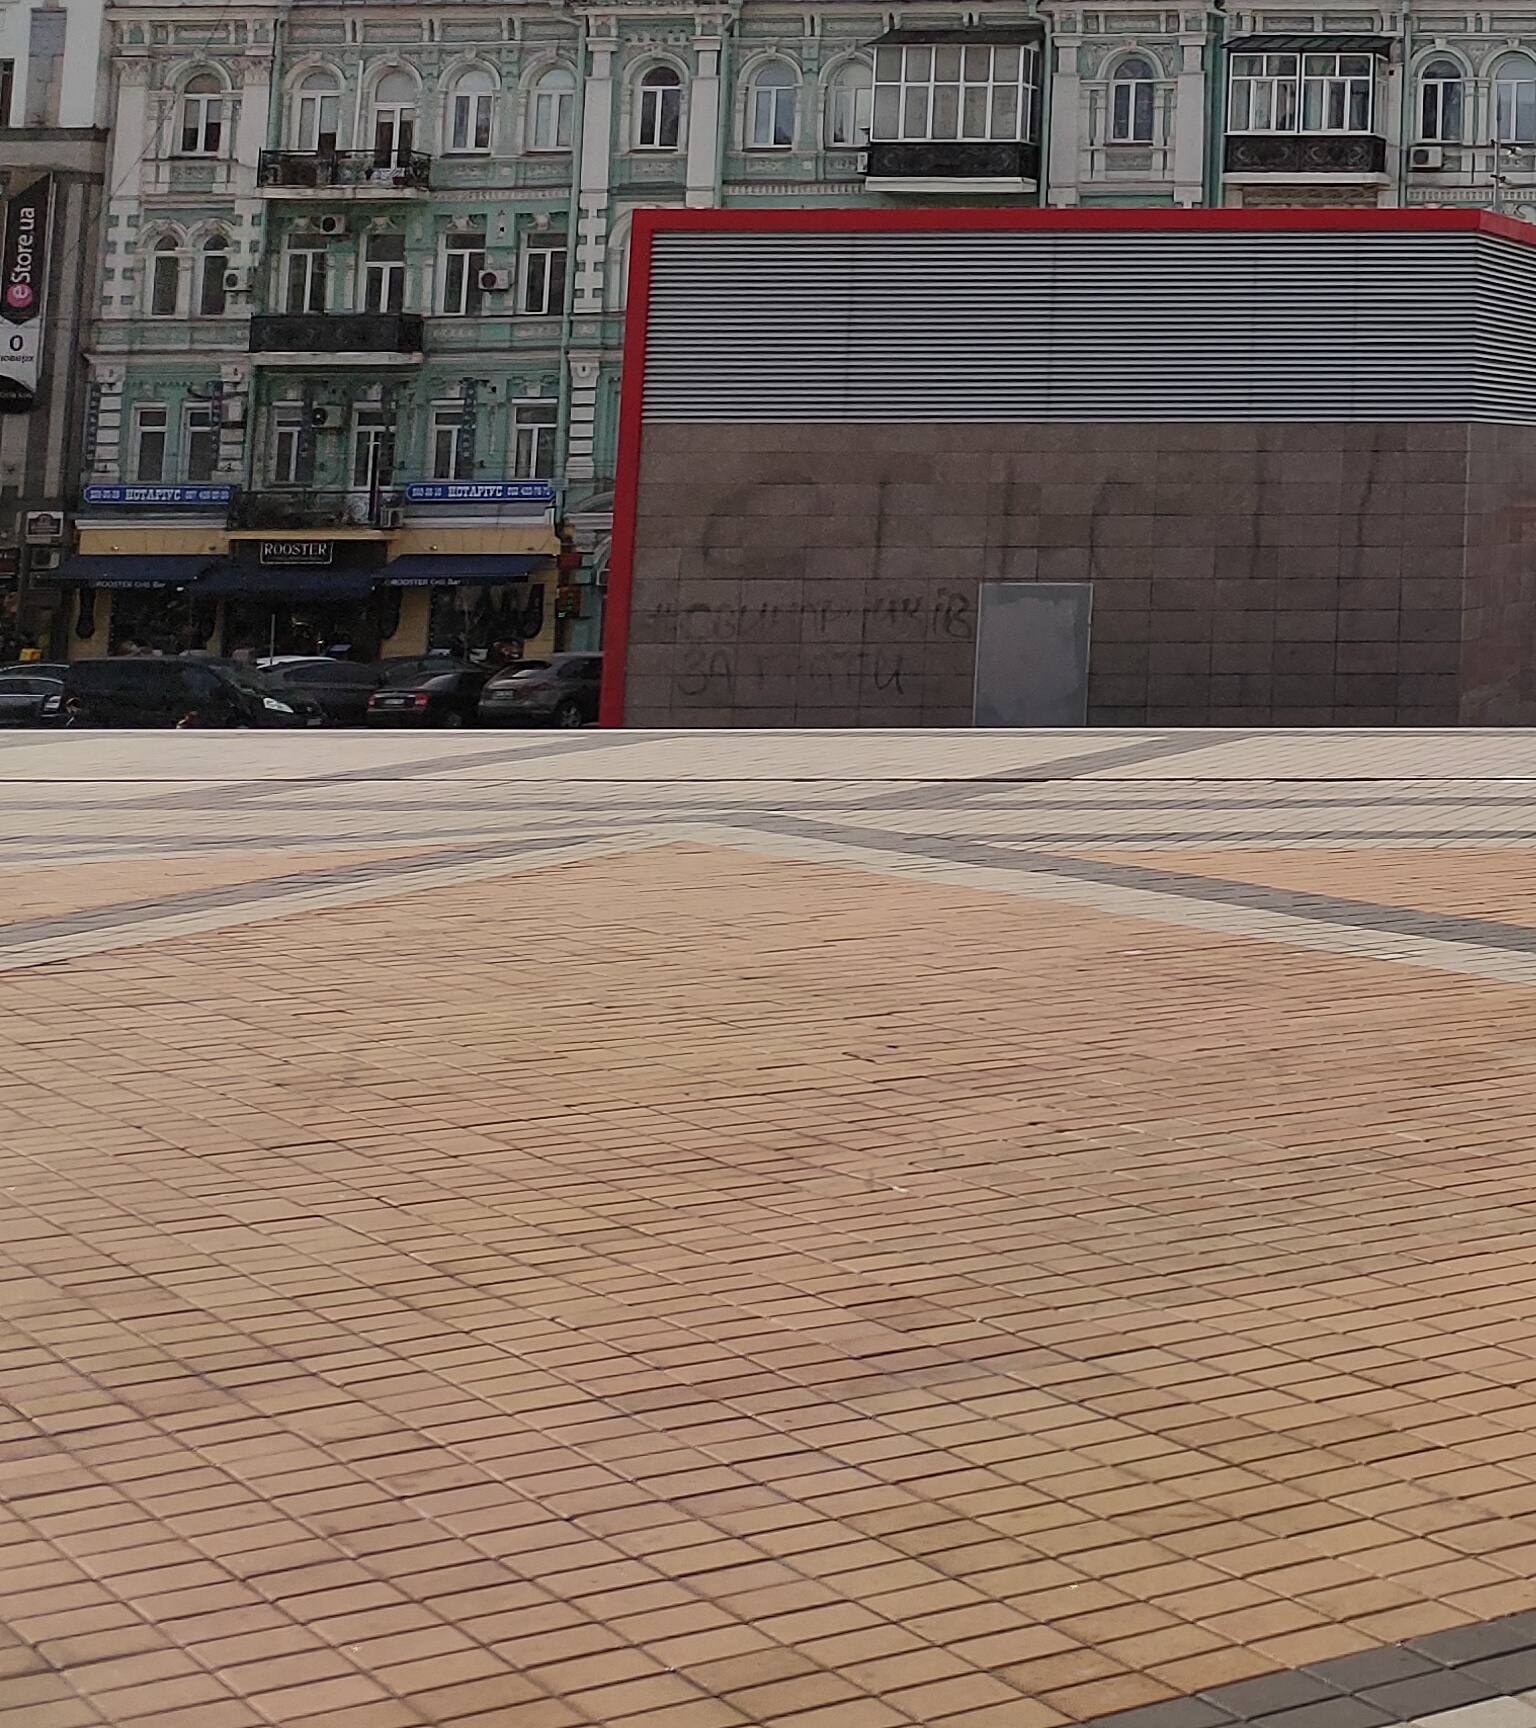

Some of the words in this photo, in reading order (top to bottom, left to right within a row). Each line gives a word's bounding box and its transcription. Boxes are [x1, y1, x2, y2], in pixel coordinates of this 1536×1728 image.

[10, 207, 35, 299] eStore.ua
[125, 489, 181, 501] НОТАРІУС
[447, 486, 503, 498] НОТАРІУС
[264, 542, 327, 556] ROOSTER
